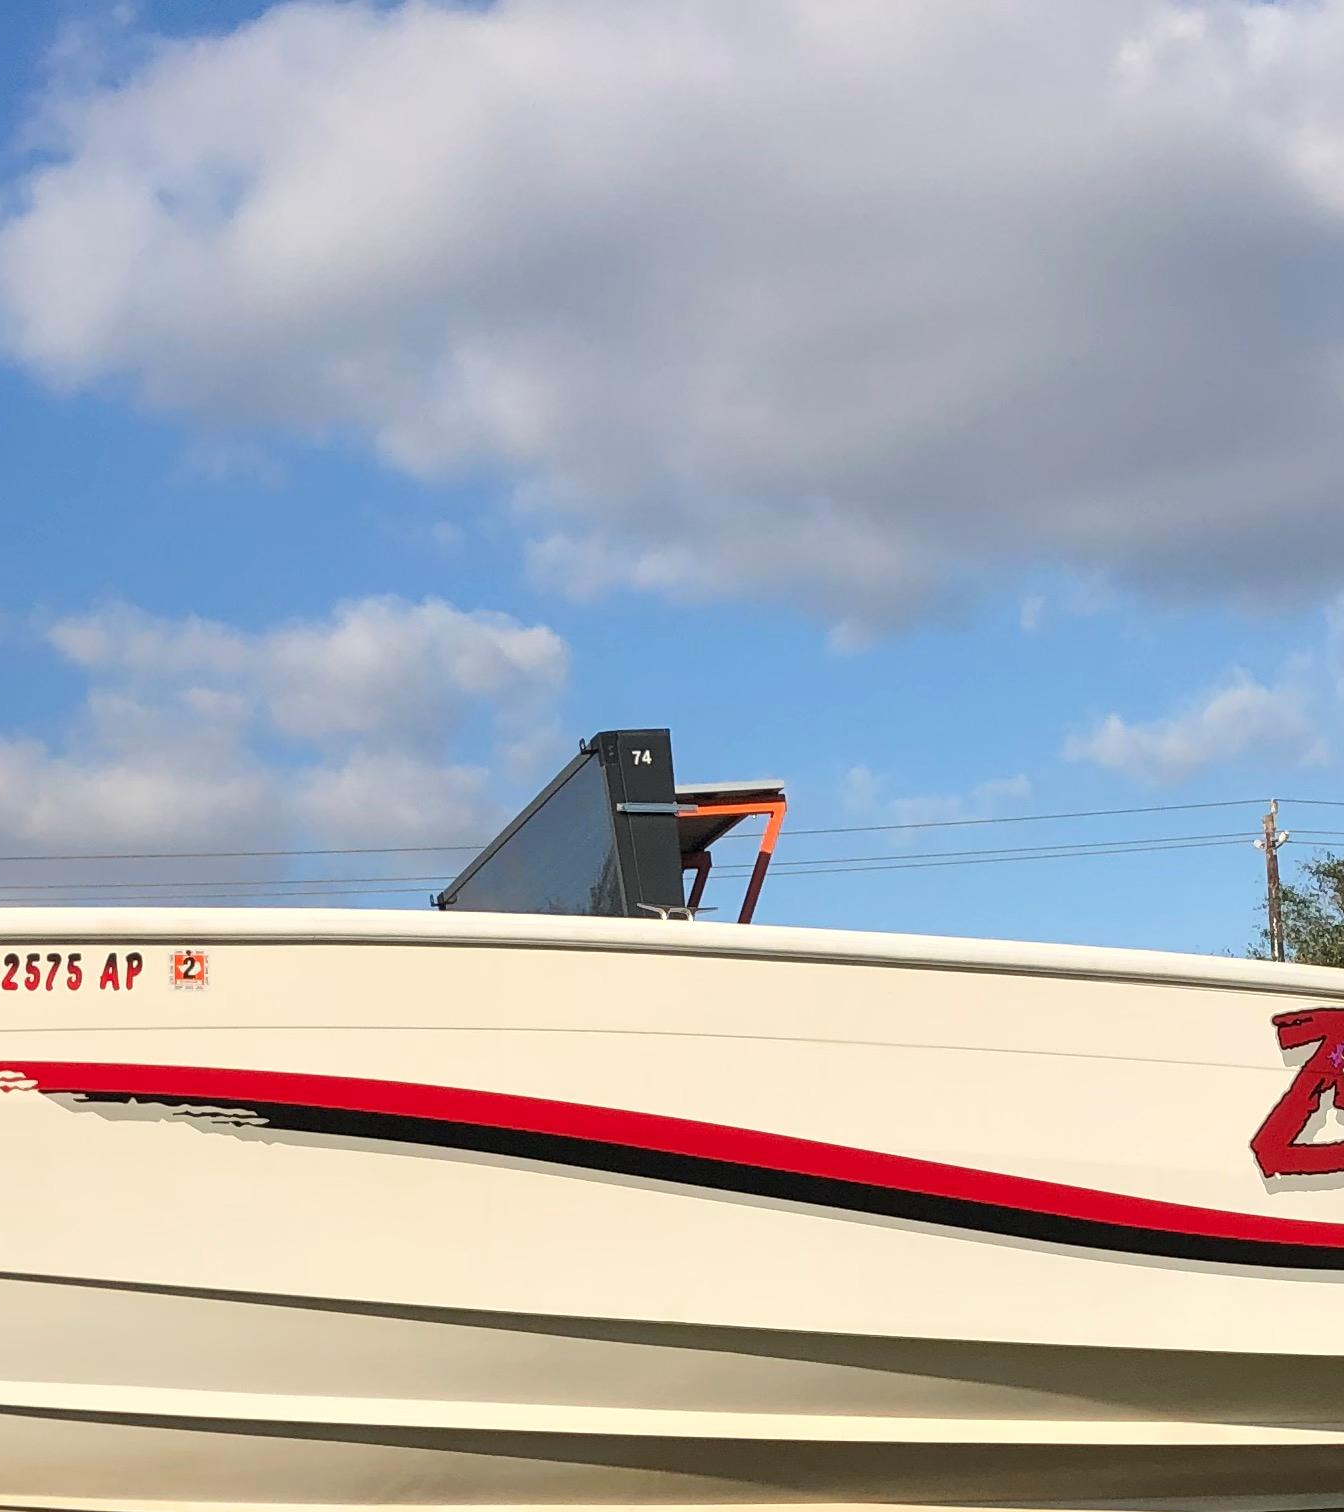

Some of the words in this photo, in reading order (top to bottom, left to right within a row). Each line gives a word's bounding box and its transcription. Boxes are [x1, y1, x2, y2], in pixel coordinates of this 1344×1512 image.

[632, 750, 653, 766] 74
[1, 952, 83, 992] 2575
[99, 951, 144, 992] AP
[183, 956, 196, 979] 2
